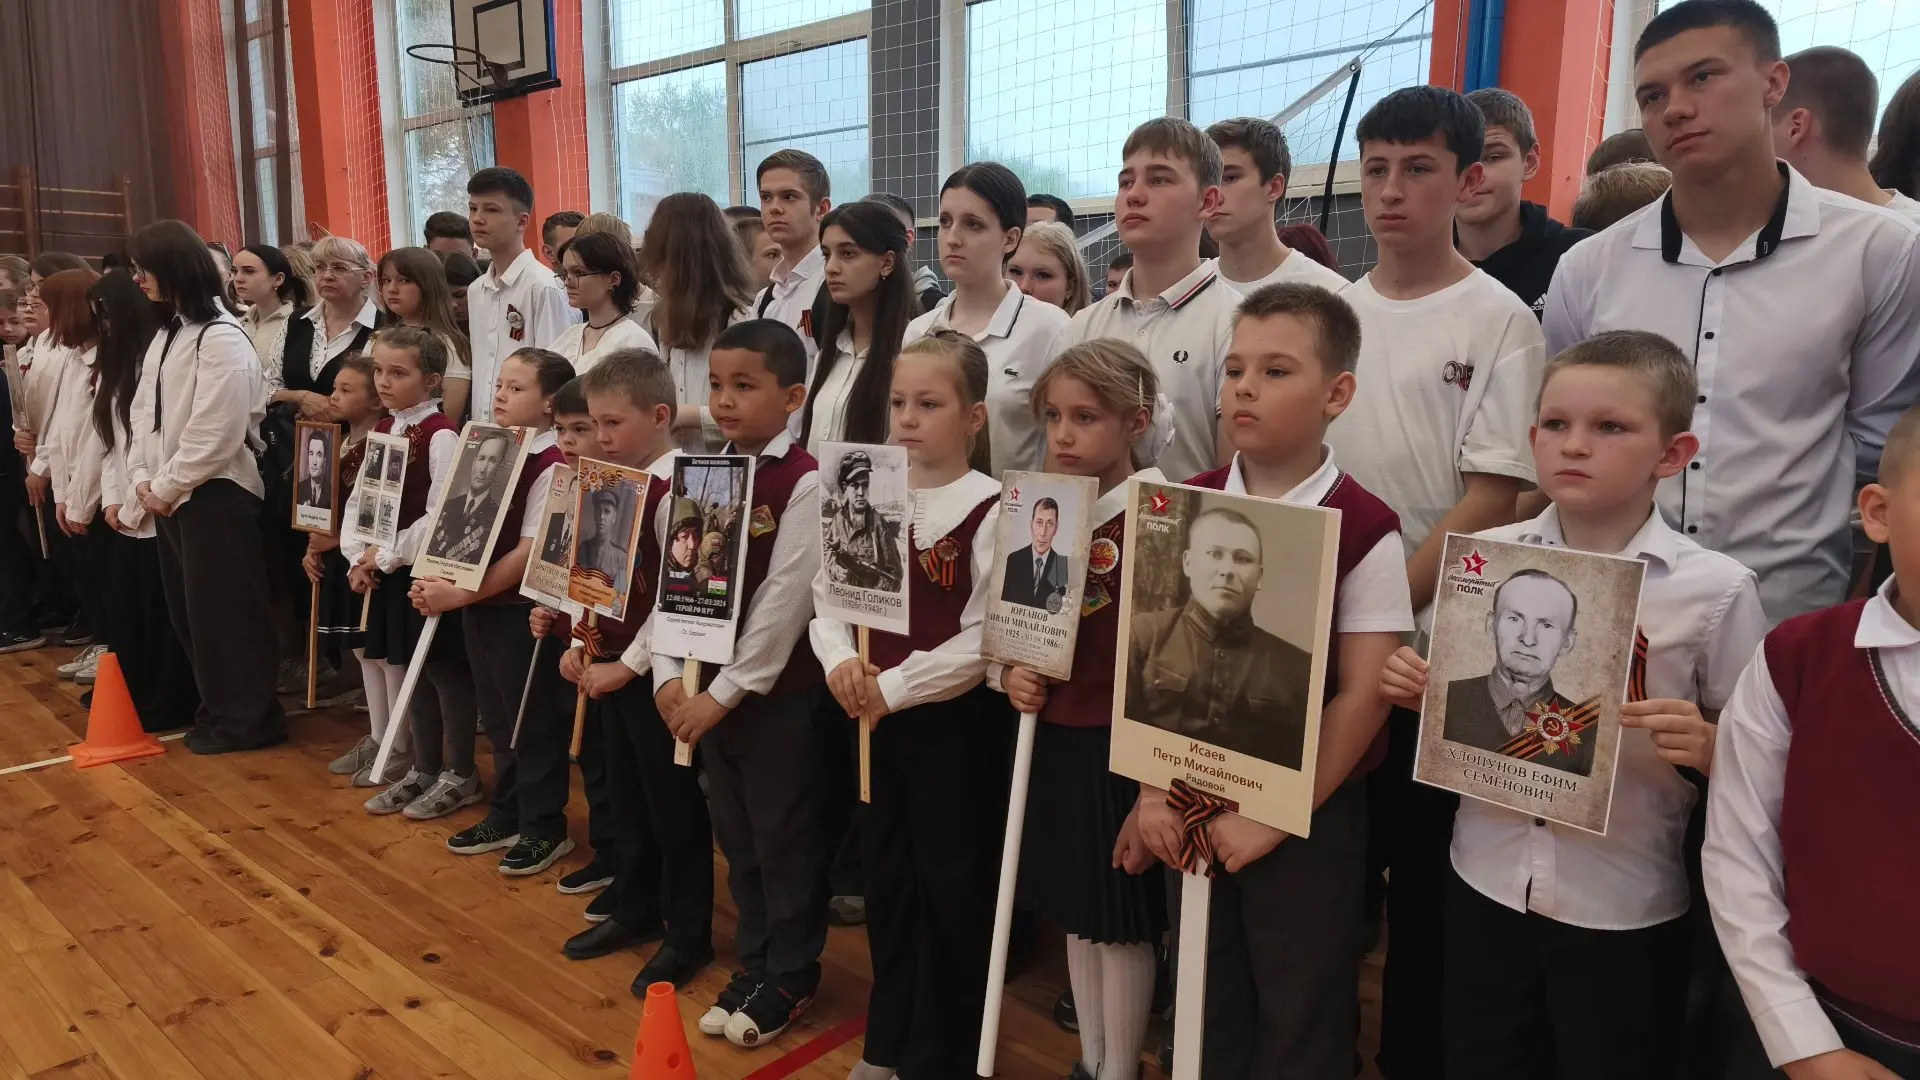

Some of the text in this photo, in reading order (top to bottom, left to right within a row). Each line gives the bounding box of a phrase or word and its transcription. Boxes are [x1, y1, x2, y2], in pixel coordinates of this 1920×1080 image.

[1146, 521, 1170, 534] ПОЛК
[829, 584, 902, 607] Леонид Голиков
[1456, 583, 1484, 596] ПОЛК
[675, 604, 692, 613] ГЕРОЙ
[1010, 606, 1049, 622] ЮРГАНОВ
[990, 612, 1068, 638] ИВАН МИХАЙЛОВИЧ
[1189, 741, 1226, 762] Исаев
[1153, 747, 1263, 792] Петр Михайлович
[1447, 747, 1578, 792] ХЛОПУНОВ ЕФИМ
[1186, 772, 1226, 793] Рядовой
